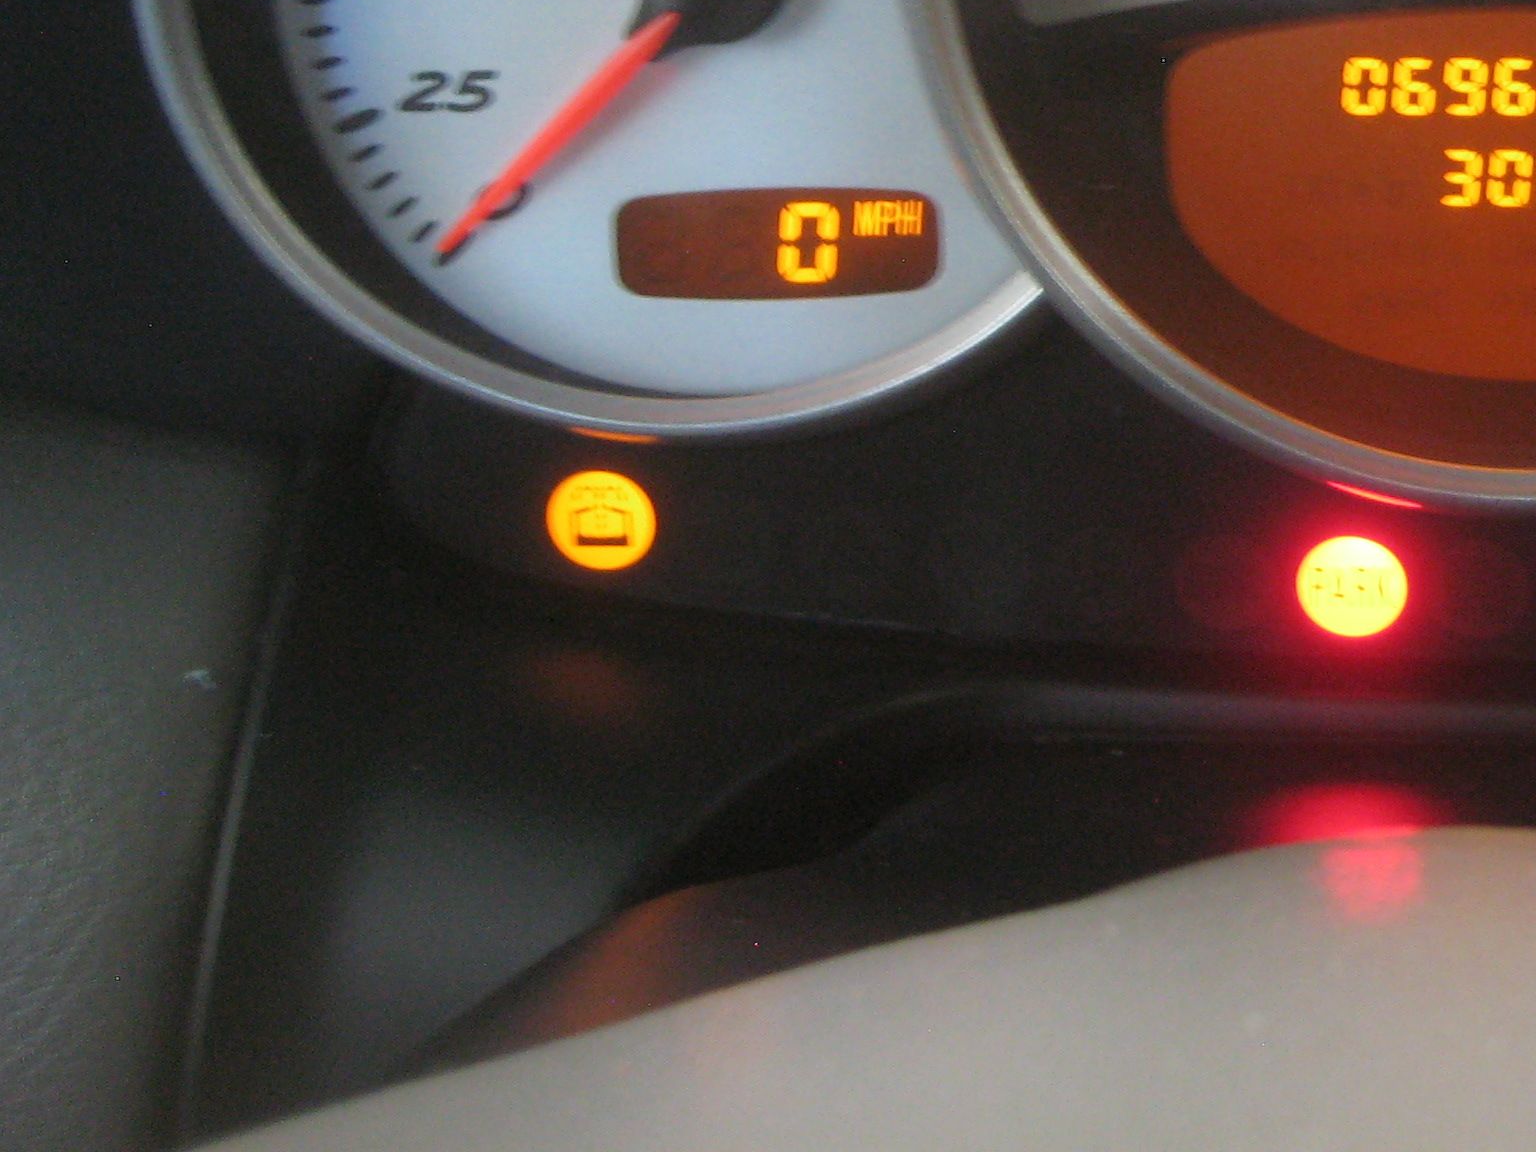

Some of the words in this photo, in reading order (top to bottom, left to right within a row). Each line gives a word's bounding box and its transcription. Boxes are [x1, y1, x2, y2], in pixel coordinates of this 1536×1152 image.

[398, 70, 498, 113] 25
[778, 202, 839, 282] 0
[853, 200, 923, 236] MPH
